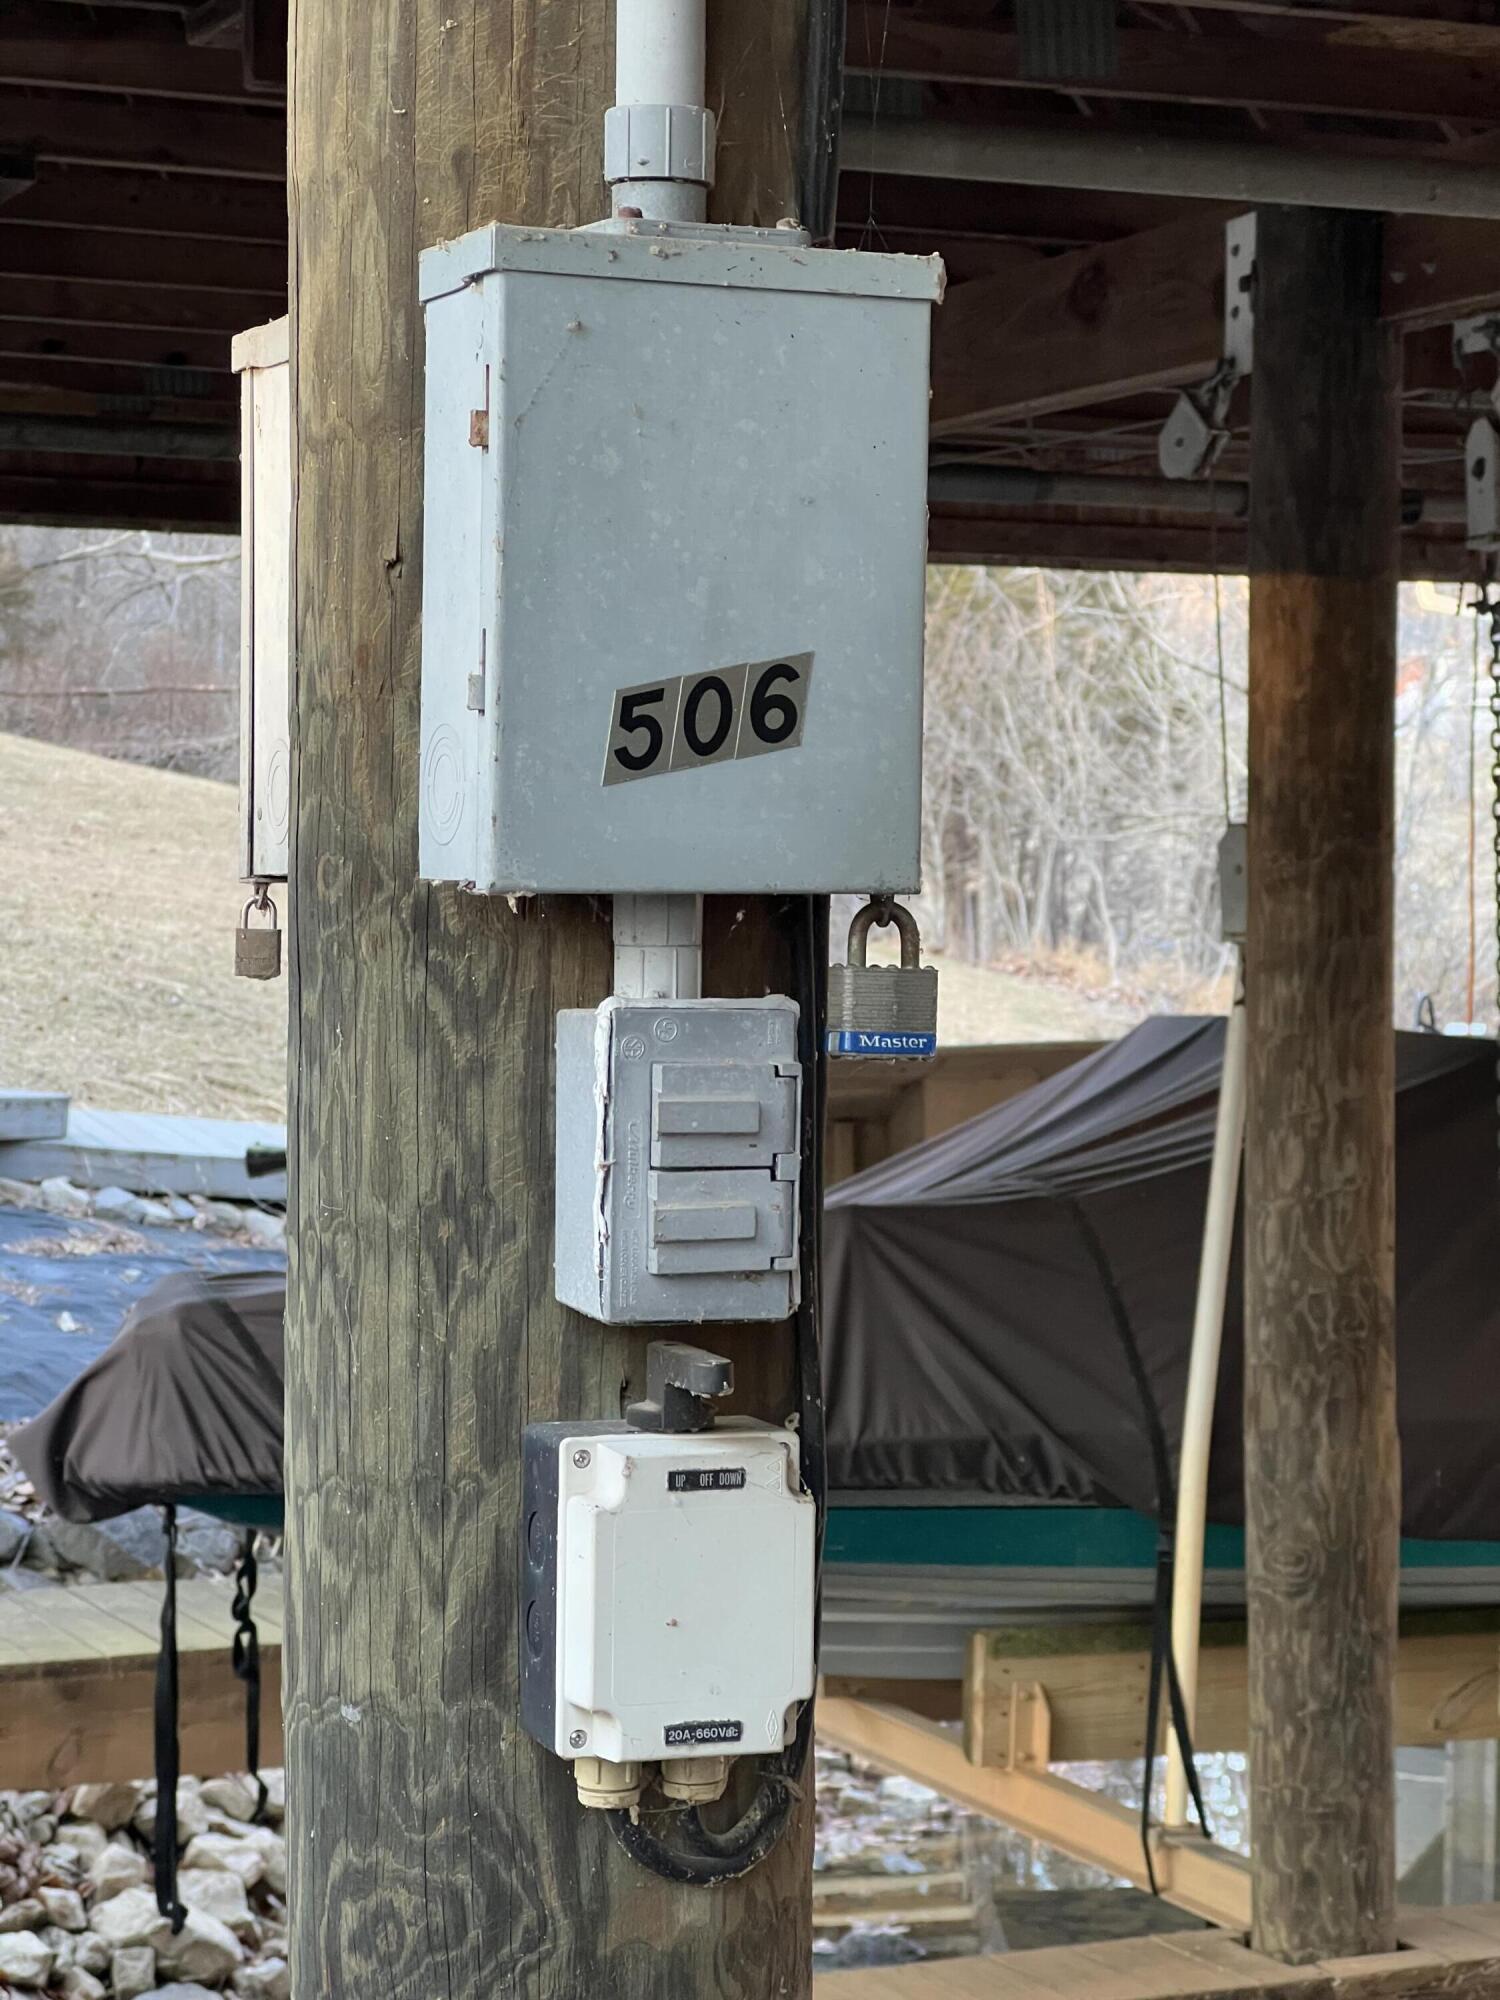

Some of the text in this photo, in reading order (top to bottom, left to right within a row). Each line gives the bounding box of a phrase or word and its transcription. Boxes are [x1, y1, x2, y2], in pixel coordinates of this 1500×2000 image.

[613, 663, 800, 770] 506
[858, 1034, 928, 1049] Master
[675, 1472, 742, 1487] UP OFF DOWN
